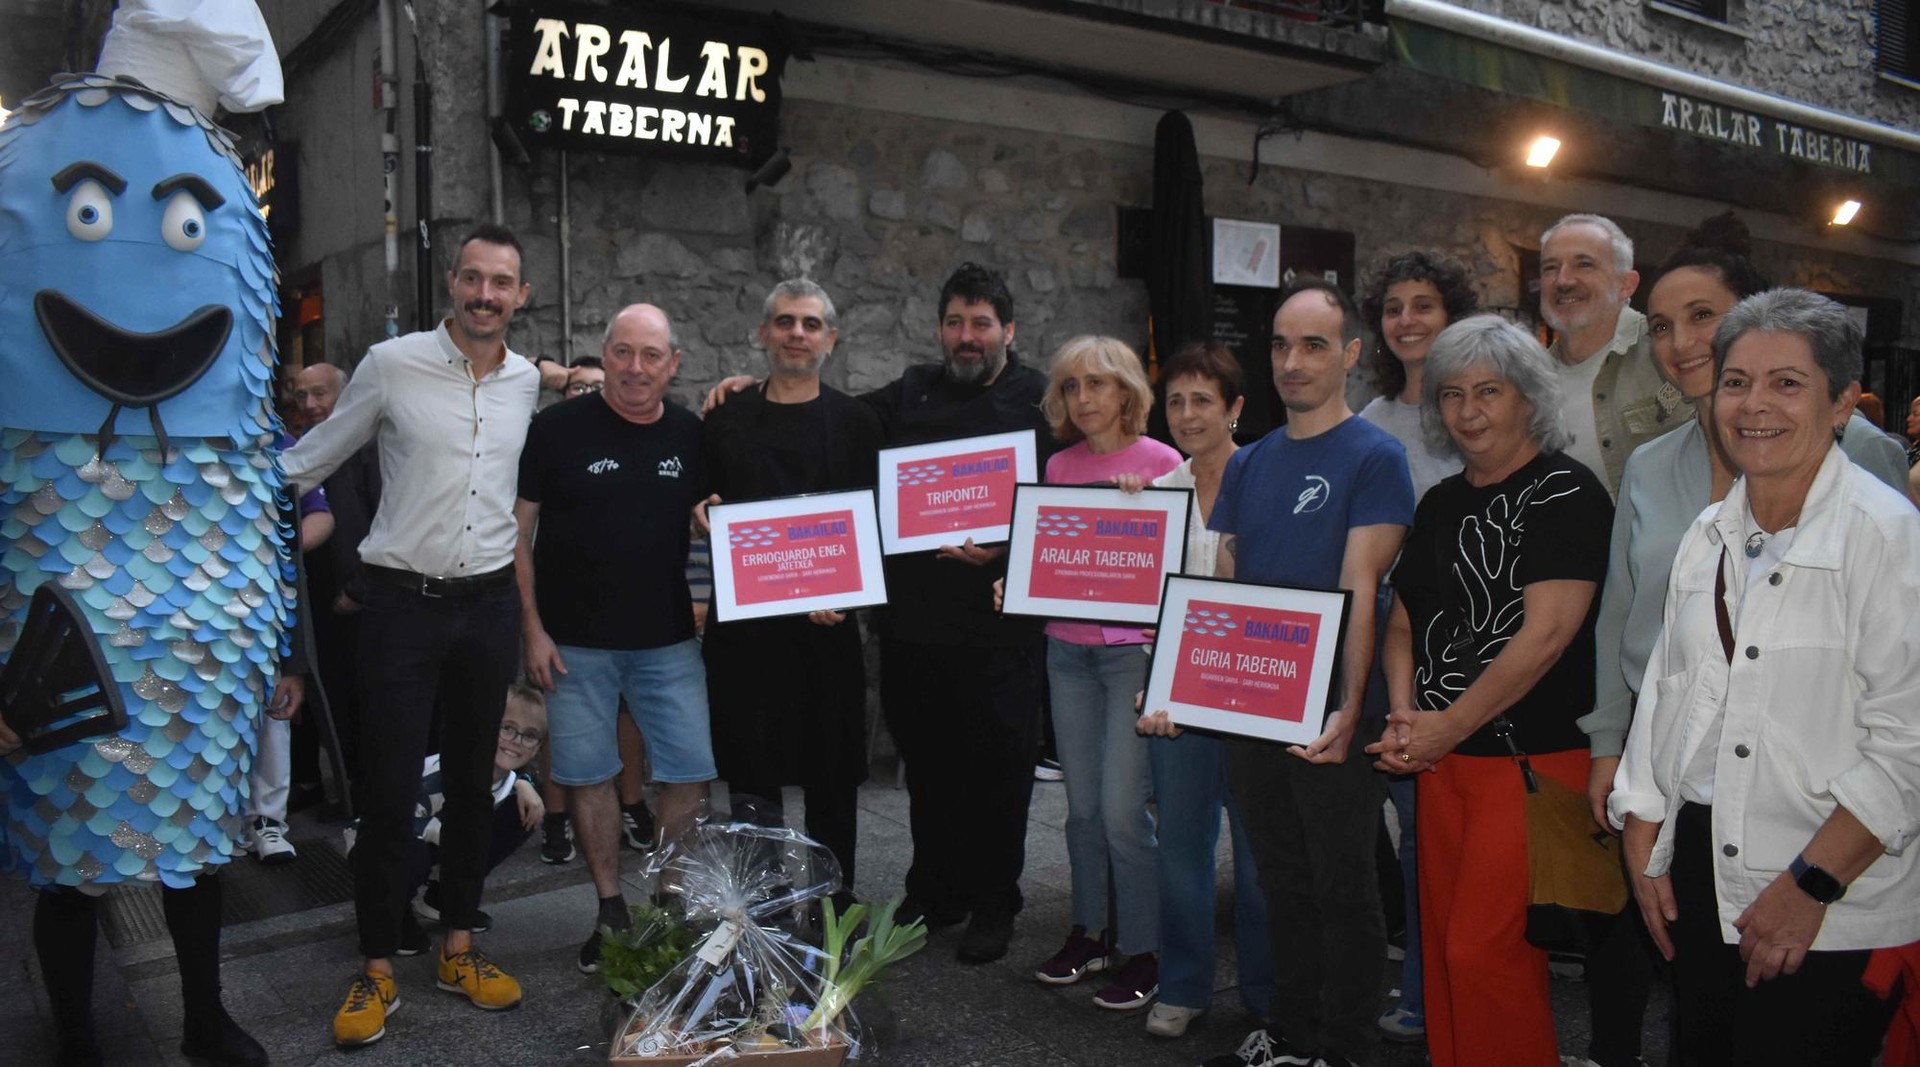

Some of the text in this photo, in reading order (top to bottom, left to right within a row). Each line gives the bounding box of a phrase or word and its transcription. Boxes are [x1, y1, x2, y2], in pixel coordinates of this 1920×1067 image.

[530, 18, 768, 103] ARALAR
[557, 98, 736, 147] TABERNA
[1661, 92, 1872, 173] ARALAR TABERNA
[926, 485, 989, 506] TRIPONTZI
[787, 521, 848, 541] BAKAILAO
[1095, 519, 1158, 538] BAKAILAO
[742, 544, 846, 567] ERRIOGUARDA ENEA
[777, 559, 814, 572] JATETXEA
[1040, 547, 1155, 569] ARALAR TABERNA
[1244, 619, 1310, 644] BAKAILAO
[1190, 648, 1297, 679] GURIA TABERNA
